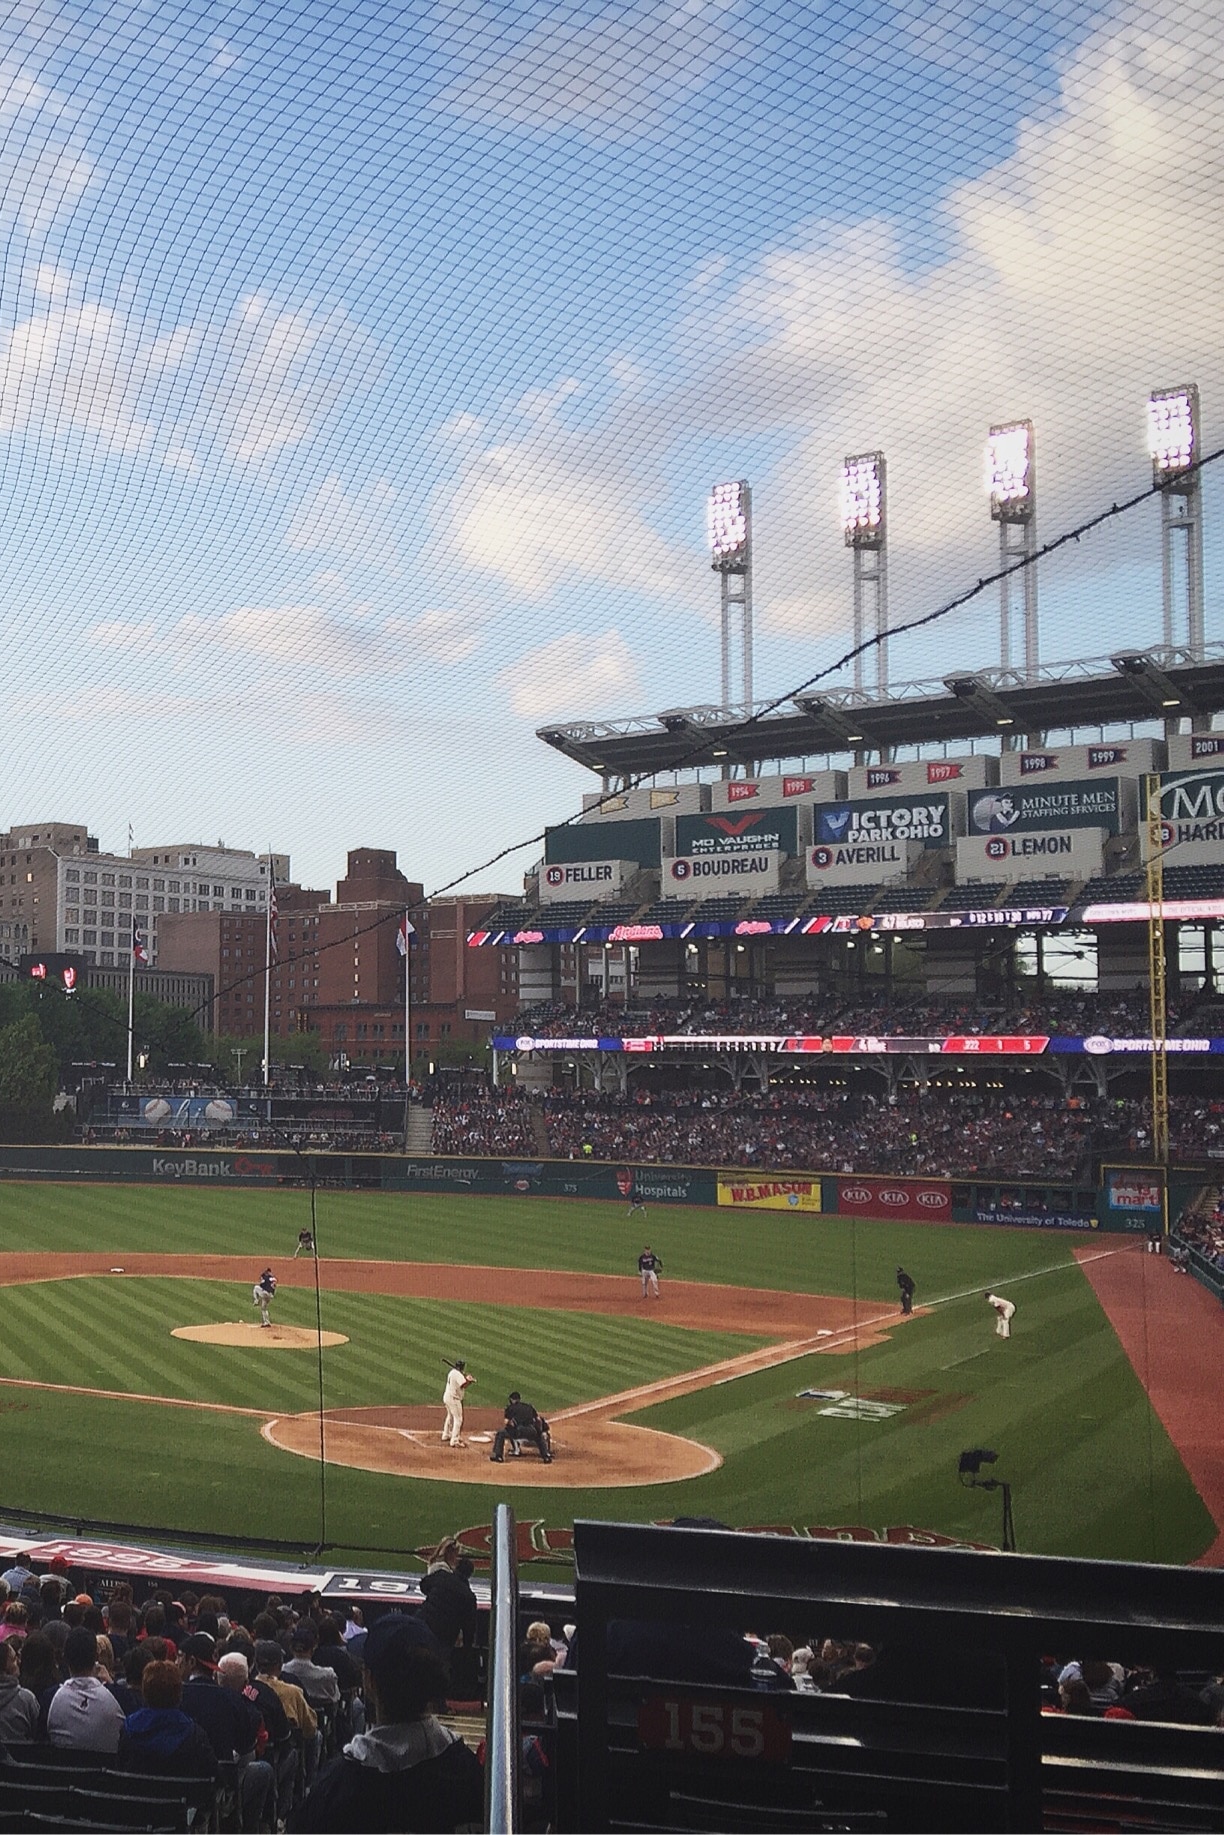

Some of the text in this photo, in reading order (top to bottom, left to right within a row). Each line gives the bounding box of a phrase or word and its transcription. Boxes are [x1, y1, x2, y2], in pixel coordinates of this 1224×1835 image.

[1196, 741, 1219, 754] 2001
[1024, 758, 1046, 769] 1998
[1093, 751, 1114, 763] 1999
[870, 773, 890, 784] 1996
[930, 768, 950, 779] 1997
[731, 786, 749, 797] 1954
[786, 782, 805, 793] 1995
[1022, 791, 1116, 810] MINUTE MEN
[1022, 803, 1116, 819] STAFFING SERVICES
[825, 805, 945, 837] VICTORY
[692, 833, 779, 847] MO VAUGHN
[848, 824, 943, 843] PARK OHIO
[692, 842, 779, 854] ENTERPRISES
[990, 836, 1072, 856] 21 LEMON
[818, 845, 900, 865] 3 AVERILL
[565, 866, 612, 882] FELLER
[677, 857, 769, 877] 5 BOUDREAU
[1183, 1039, 1210, 1051] OHIO
[153, 1158, 231, 1176] KeyBank
[407, 1164, 479, 1180] FirstEnergy
[635, 1169, 692, 1185] University
[635, 1183, 688, 1199] Hospitals
[847, 1191, 943, 1205] KIA KIA KIA
[977, 1212, 1090, 1227] The University of Toledo
[1126, 1218, 1145, 1229] 325
[41, 1545, 190, 1569] 1995
[664, 1702, 765, 1756] 155
